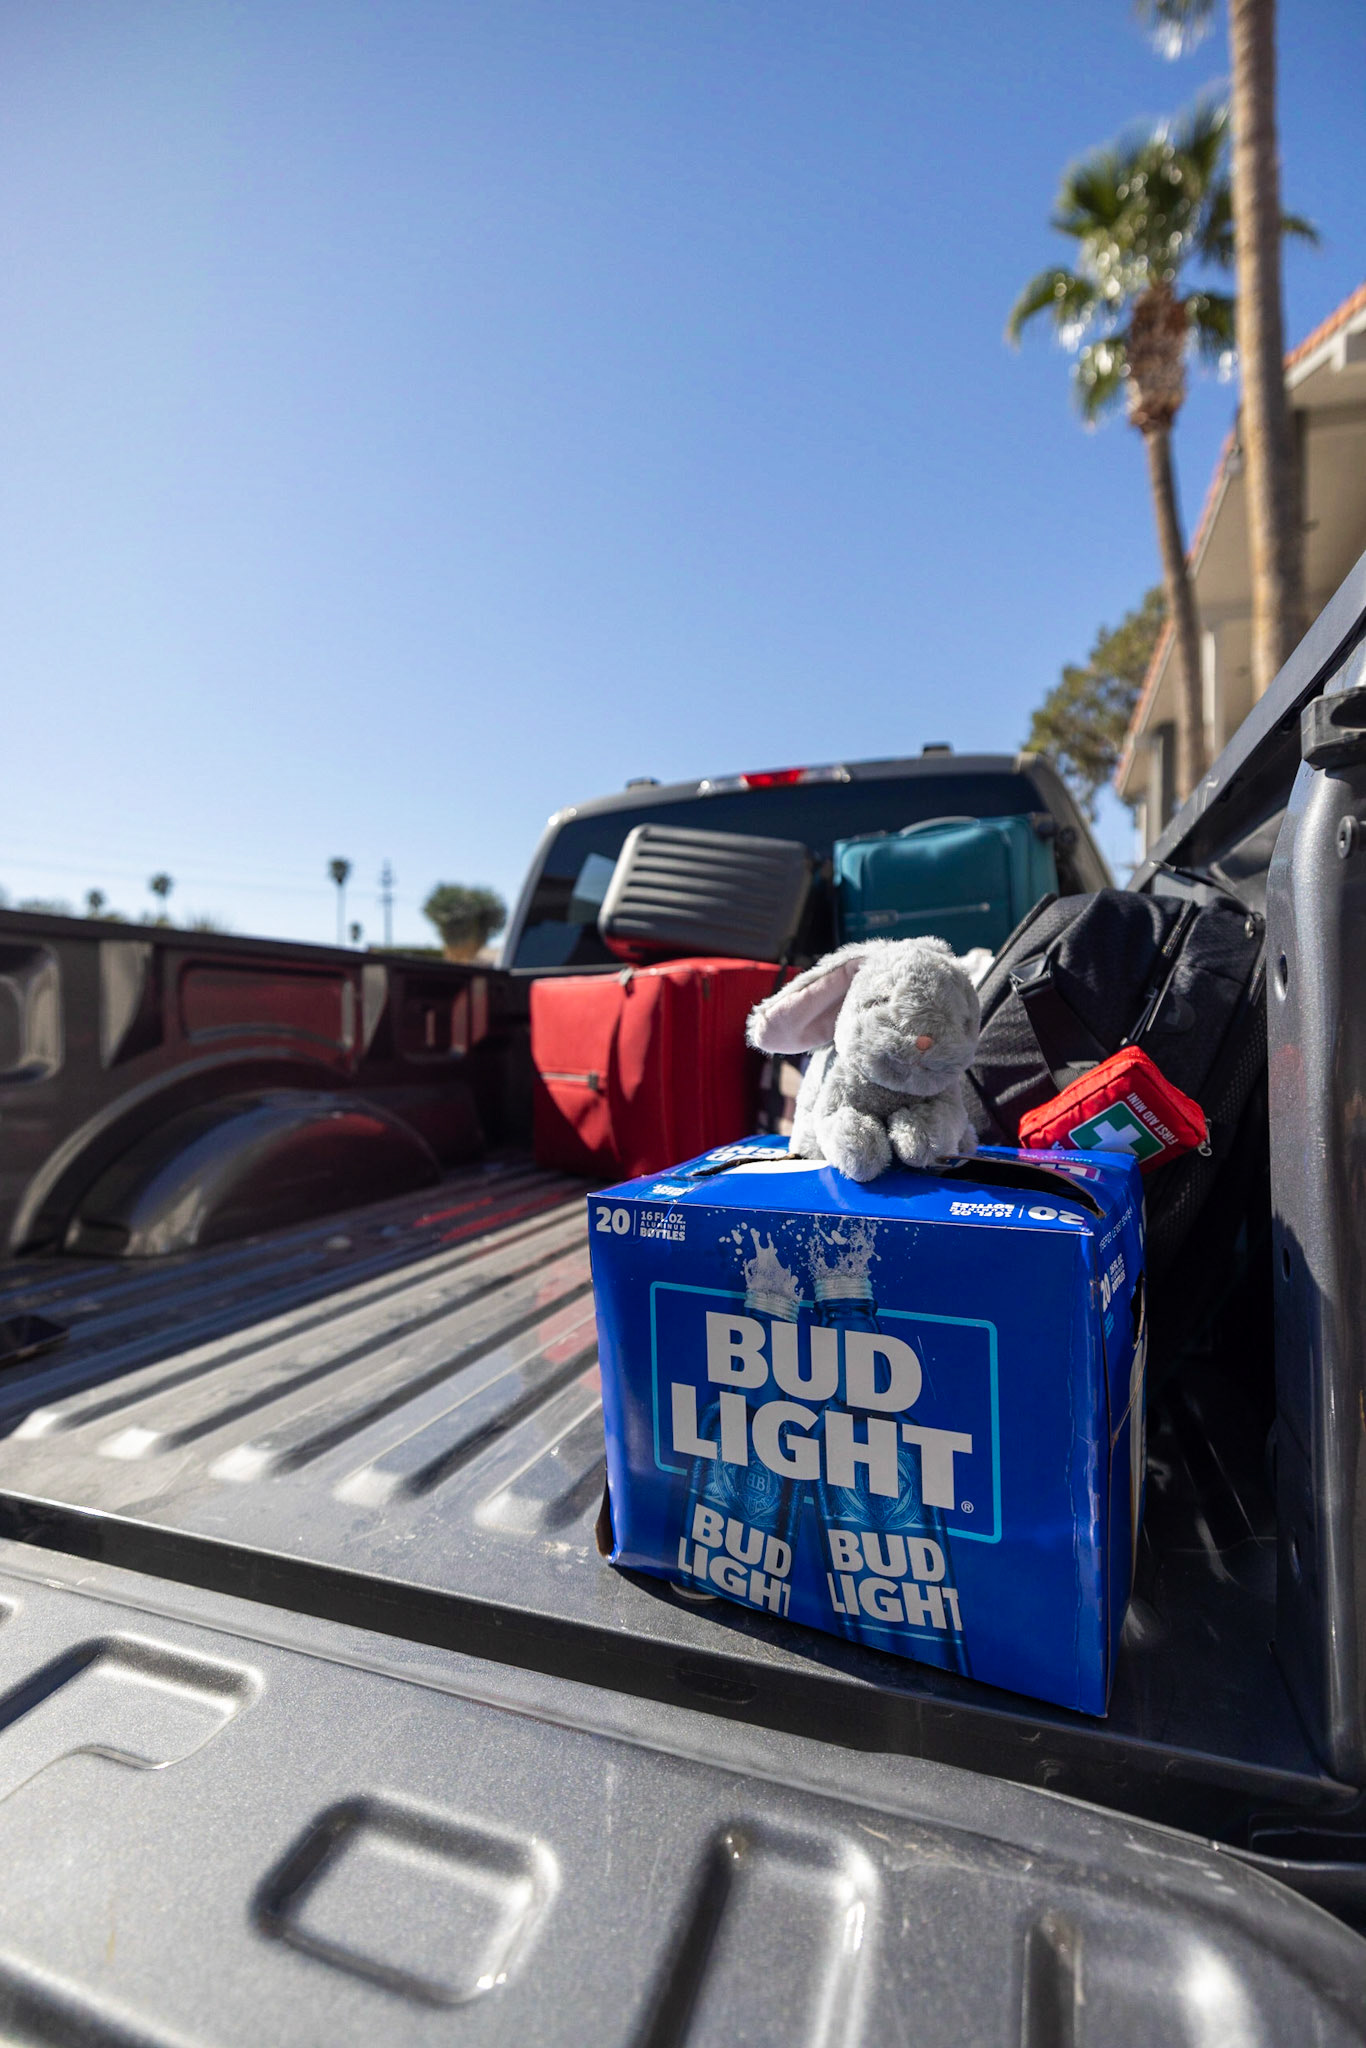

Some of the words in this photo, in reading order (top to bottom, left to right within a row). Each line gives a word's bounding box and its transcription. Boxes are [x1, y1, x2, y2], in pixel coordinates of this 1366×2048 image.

[1126, 1092, 1148, 1115] MINI
[1142, 1110, 1160, 1128] AID
[1155, 1123, 1179, 1146] FIRST
[596, 1206, 631, 1236] 20
[640, 1211, 654, 1221] 16
[669, 1213, 687, 1225] OZ.
[640, 1220, 686, 1232] ALUMINUM
[1028, 1206, 1085, 1226] 20
[640, 1227, 686, 1242] BOTTLES
[705, 1310, 923, 1413] BUD
[671, 1382, 973, 1510] LIGHT
[692, 1503, 792, 1578] BUD
[828, 1529, 946, 1583] BUD
[677, 1537, 791, 1617] LIGHT
[827, 1572, 963, 1631] LIGHT
